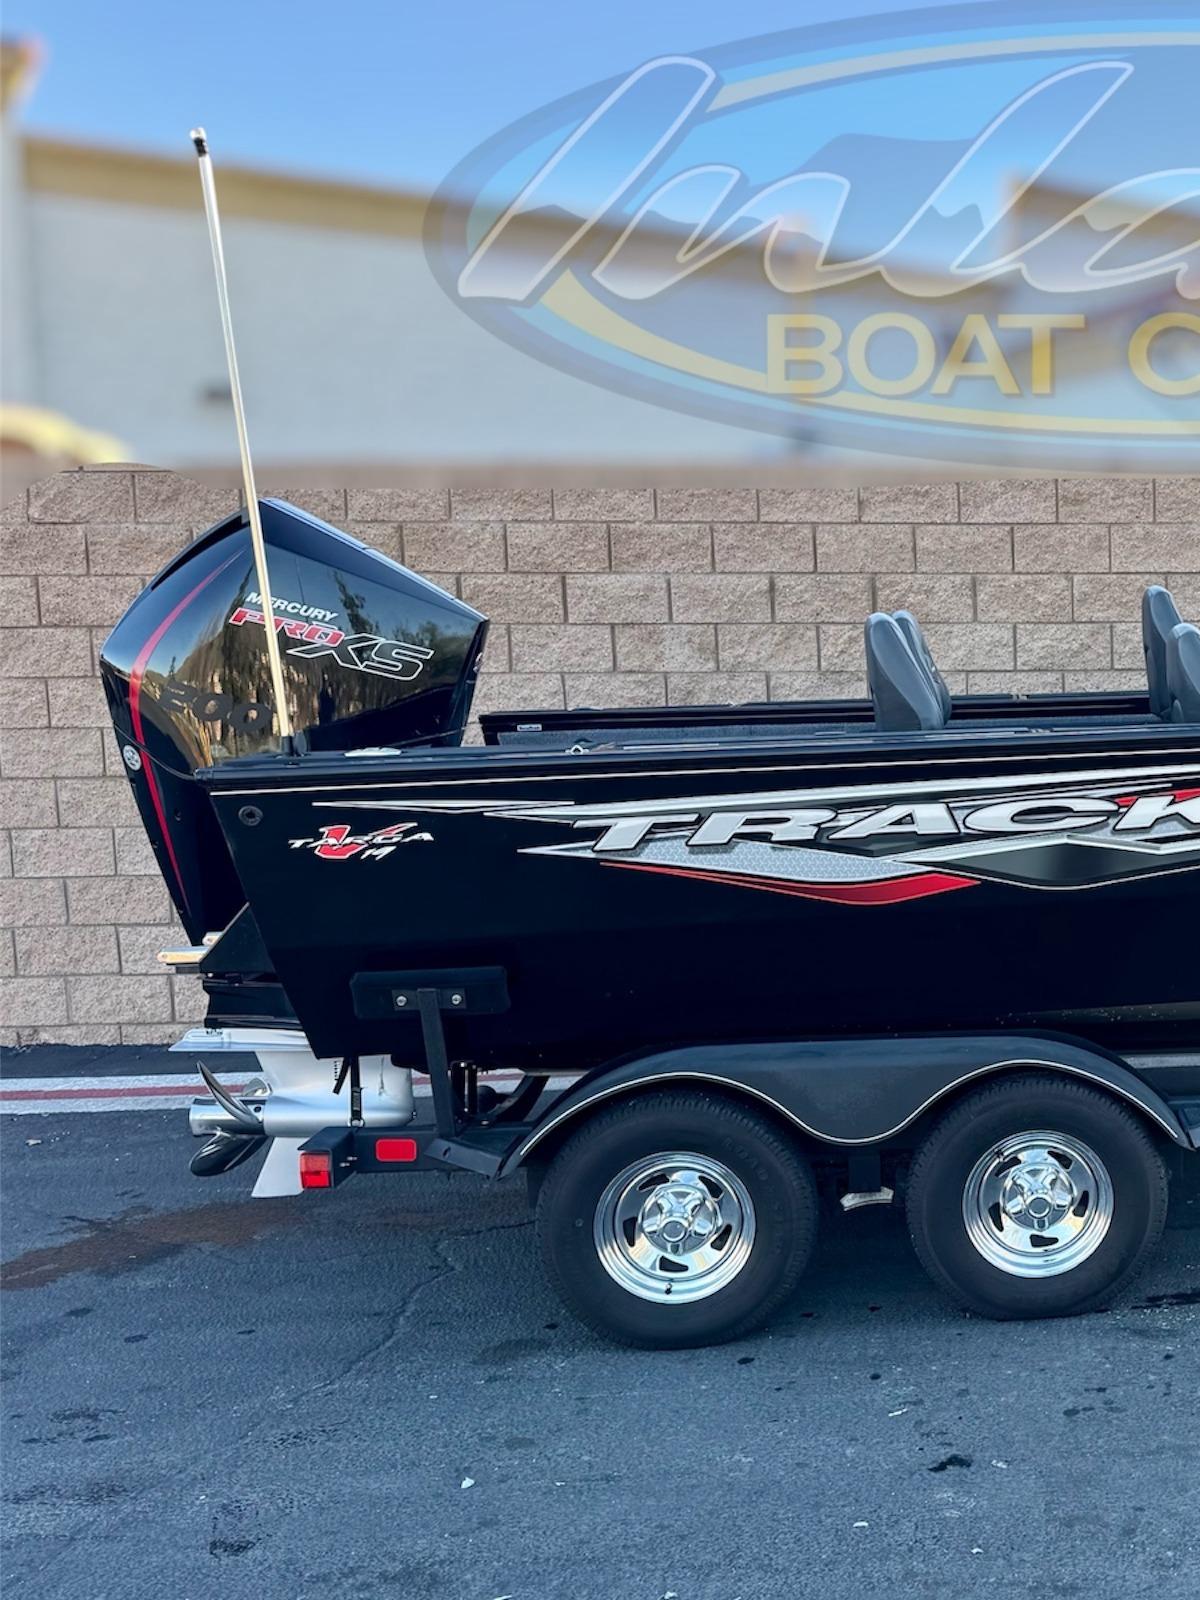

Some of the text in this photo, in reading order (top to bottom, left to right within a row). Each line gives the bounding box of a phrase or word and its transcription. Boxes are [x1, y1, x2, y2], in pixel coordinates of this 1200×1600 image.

[228, 607, 435, 681] PRO XS
[287, 831, 435, 850] TARGA
